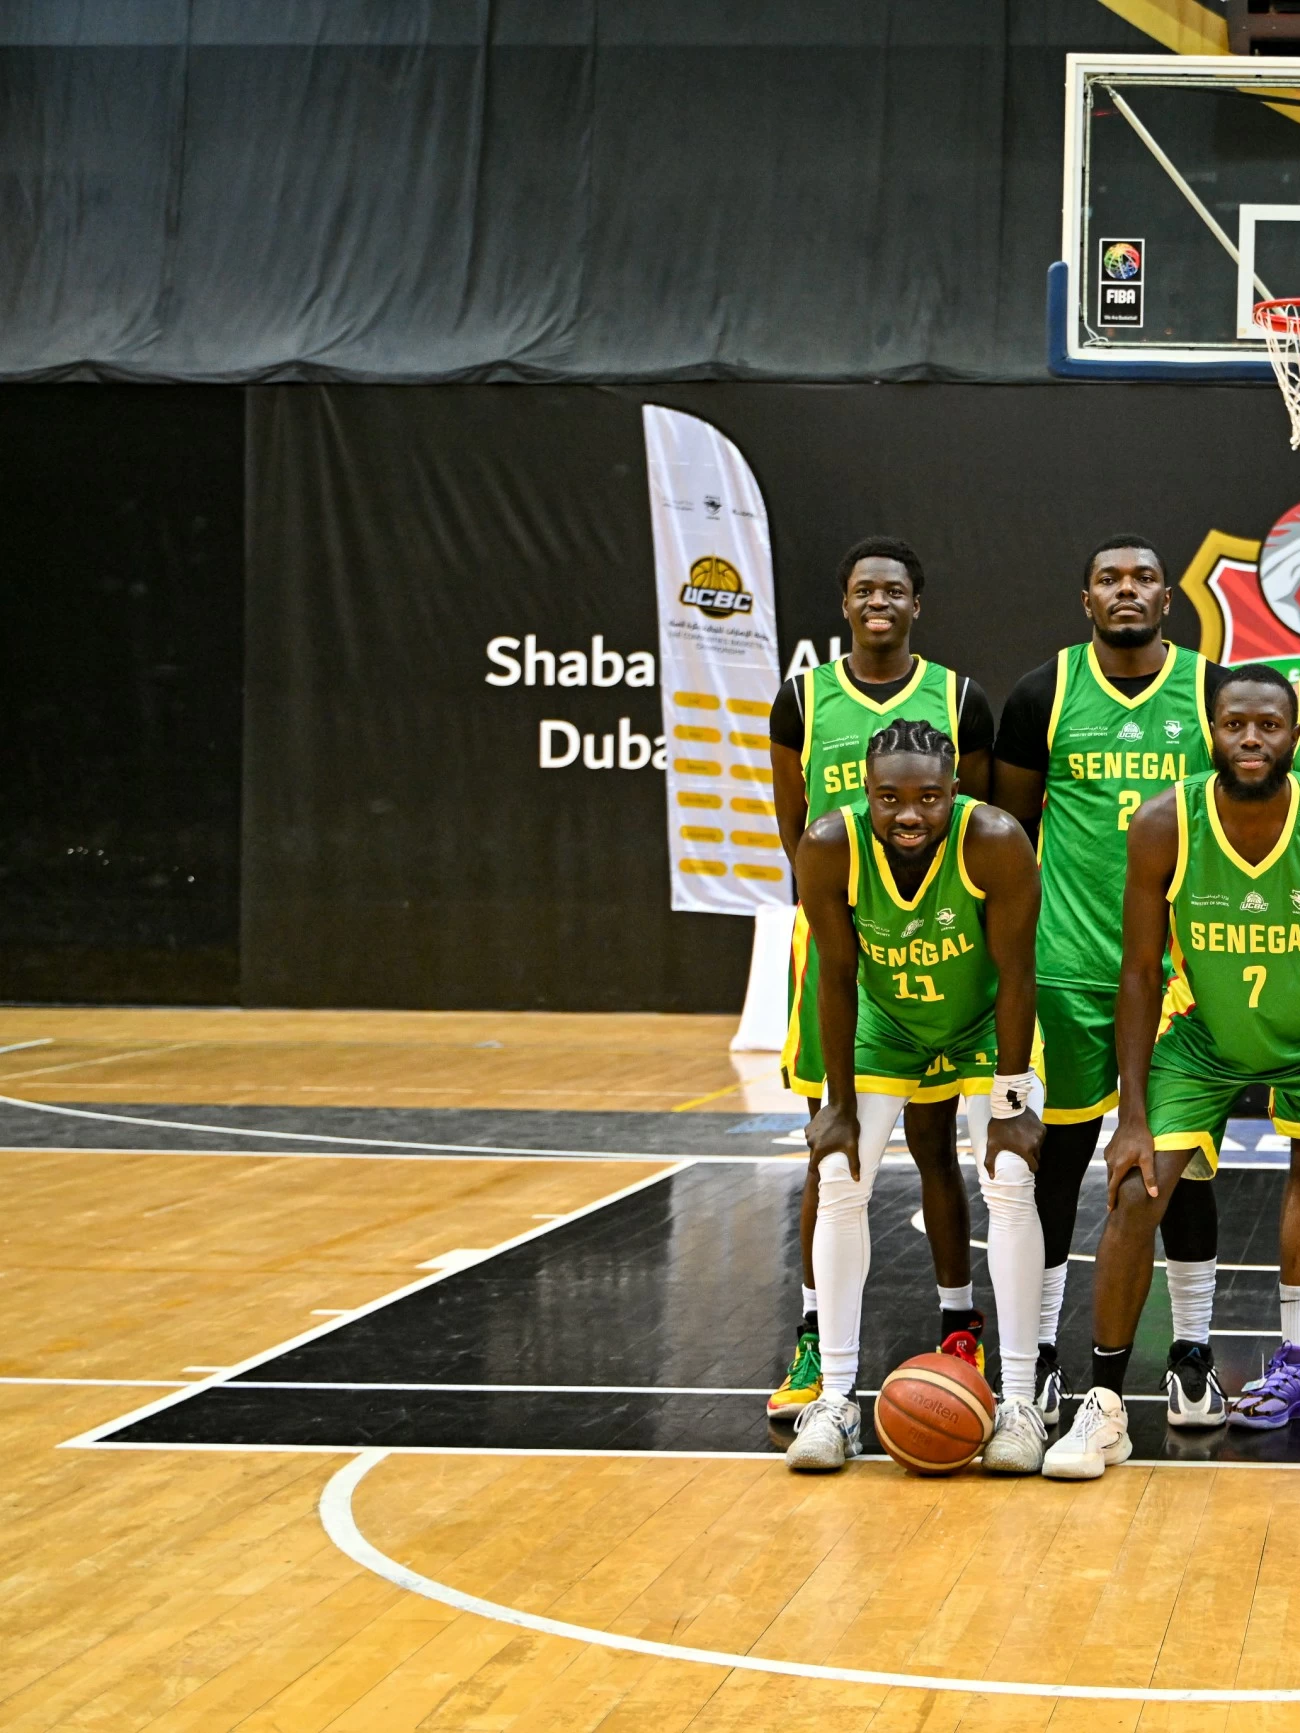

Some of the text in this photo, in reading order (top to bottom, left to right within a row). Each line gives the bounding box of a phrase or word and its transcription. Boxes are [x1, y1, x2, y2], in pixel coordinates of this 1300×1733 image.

[1106, 289, 1136, 304] FIBA
[683, 586, 752, 611] UCBC
[485, 634, 656, 687] Shaba
[539, 717, 667, 770] Duba
[1118, 731, 1144, 739] UCBC
[1068, 752, 1190, 780] SENEGAL
[1241, 902, 1268, 911] UCBC
[858, 931, 975, 968] SENEGAL
[892, 971, 945, 1002] 11
[1242, 965, 1267, 1009] 7
[909, 1391, 960, 1425] molten
